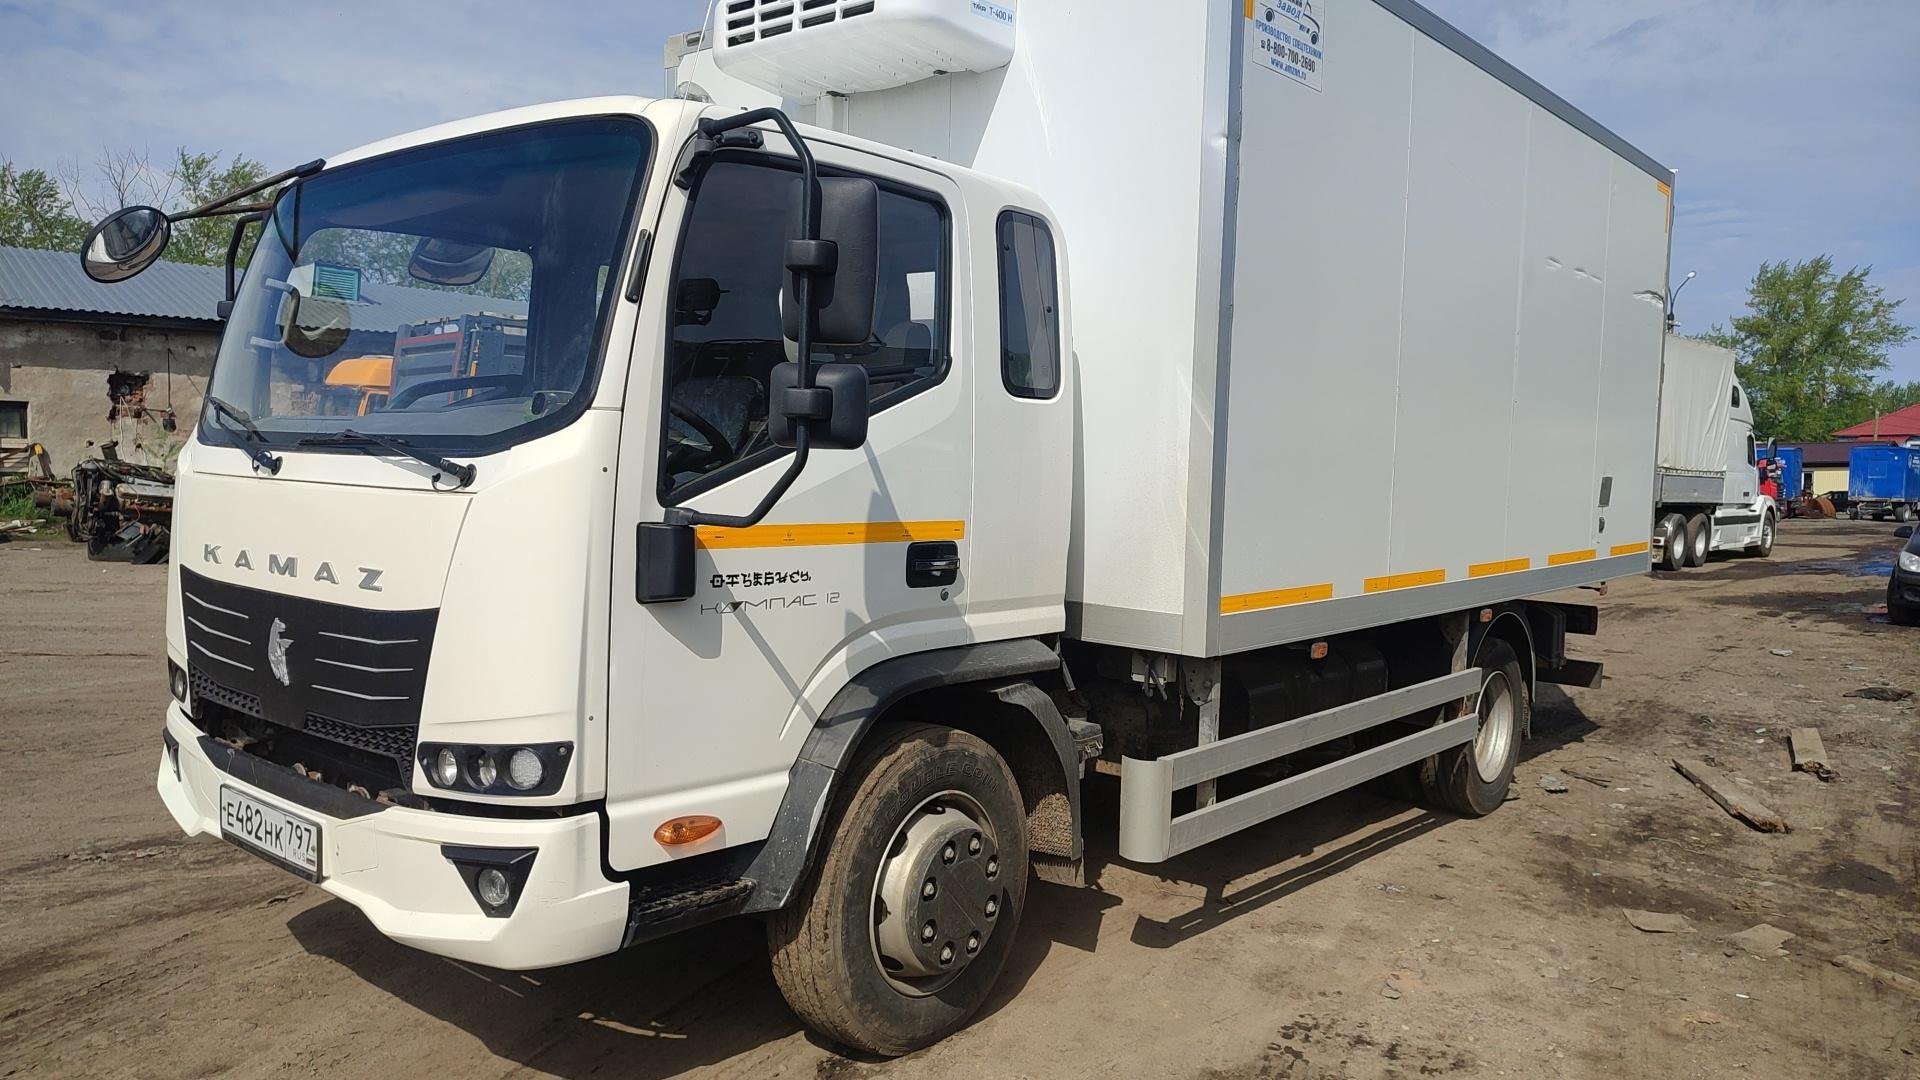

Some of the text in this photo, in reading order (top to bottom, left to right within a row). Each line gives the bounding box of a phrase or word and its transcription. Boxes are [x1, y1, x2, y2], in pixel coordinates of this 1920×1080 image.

[1255, 18, 1292, 45] ПРОИЗВОДСТВО
[203, 543, 384, 593] KAMAZ
[826, 591, 840, 605] 12
[286, 819, 312, 854] 797
